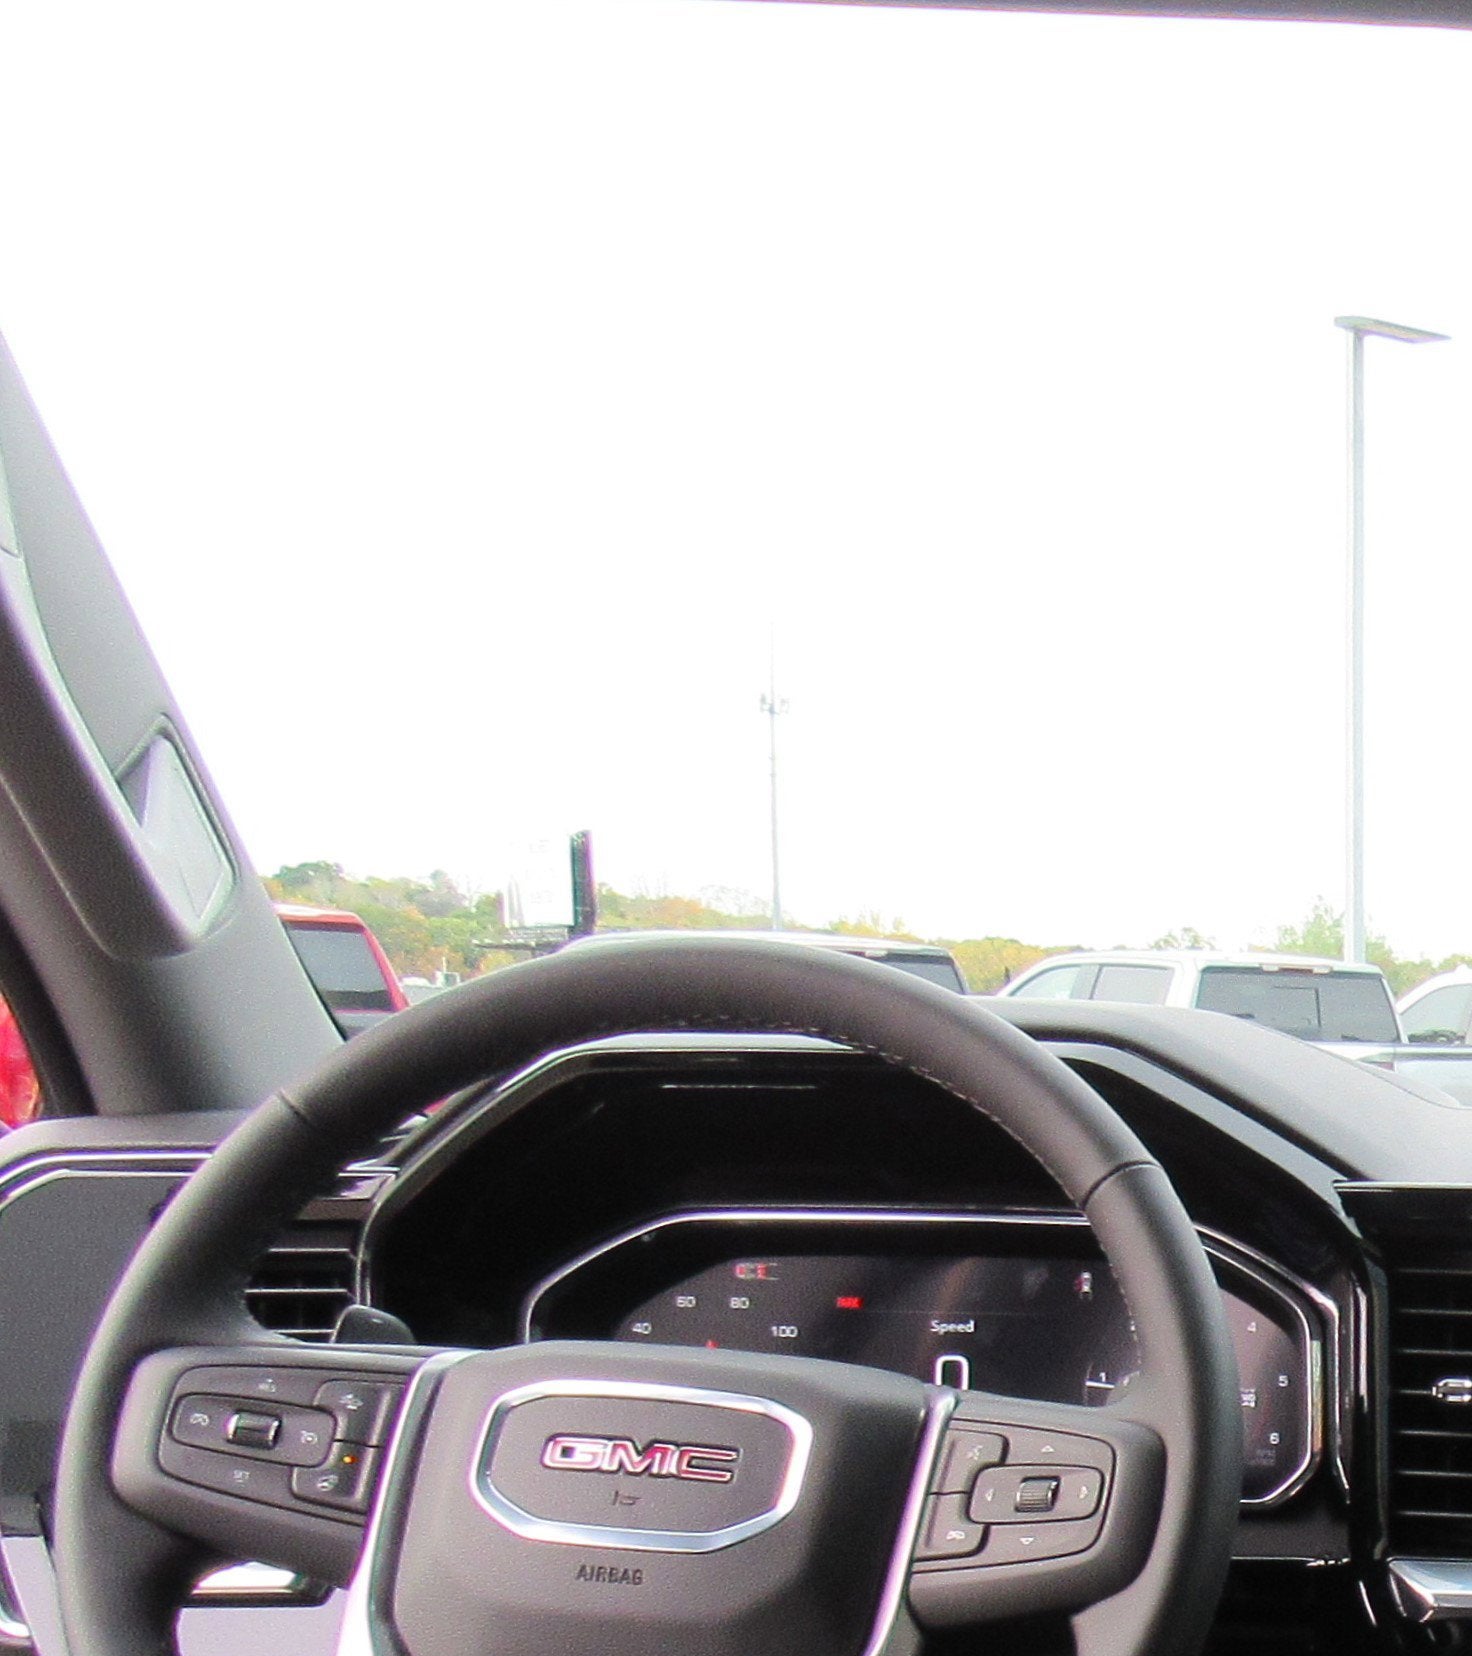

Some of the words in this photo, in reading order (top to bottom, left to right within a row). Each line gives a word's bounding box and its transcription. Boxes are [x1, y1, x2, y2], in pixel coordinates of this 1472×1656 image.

[729, 1296, 750, 1309] 80
[631, 1322, 652, 1335] 40
[770, 1325, 799, 1338] 100
[930, 1319, 976, 1335] Speed
[1278, 1374, 1289, 1387] 5
[1269, 1432, 1280, 1445] 6
[542, 1434, 739, 1483] GMC
[575, 1563, 644, 1586] AIRBAG
